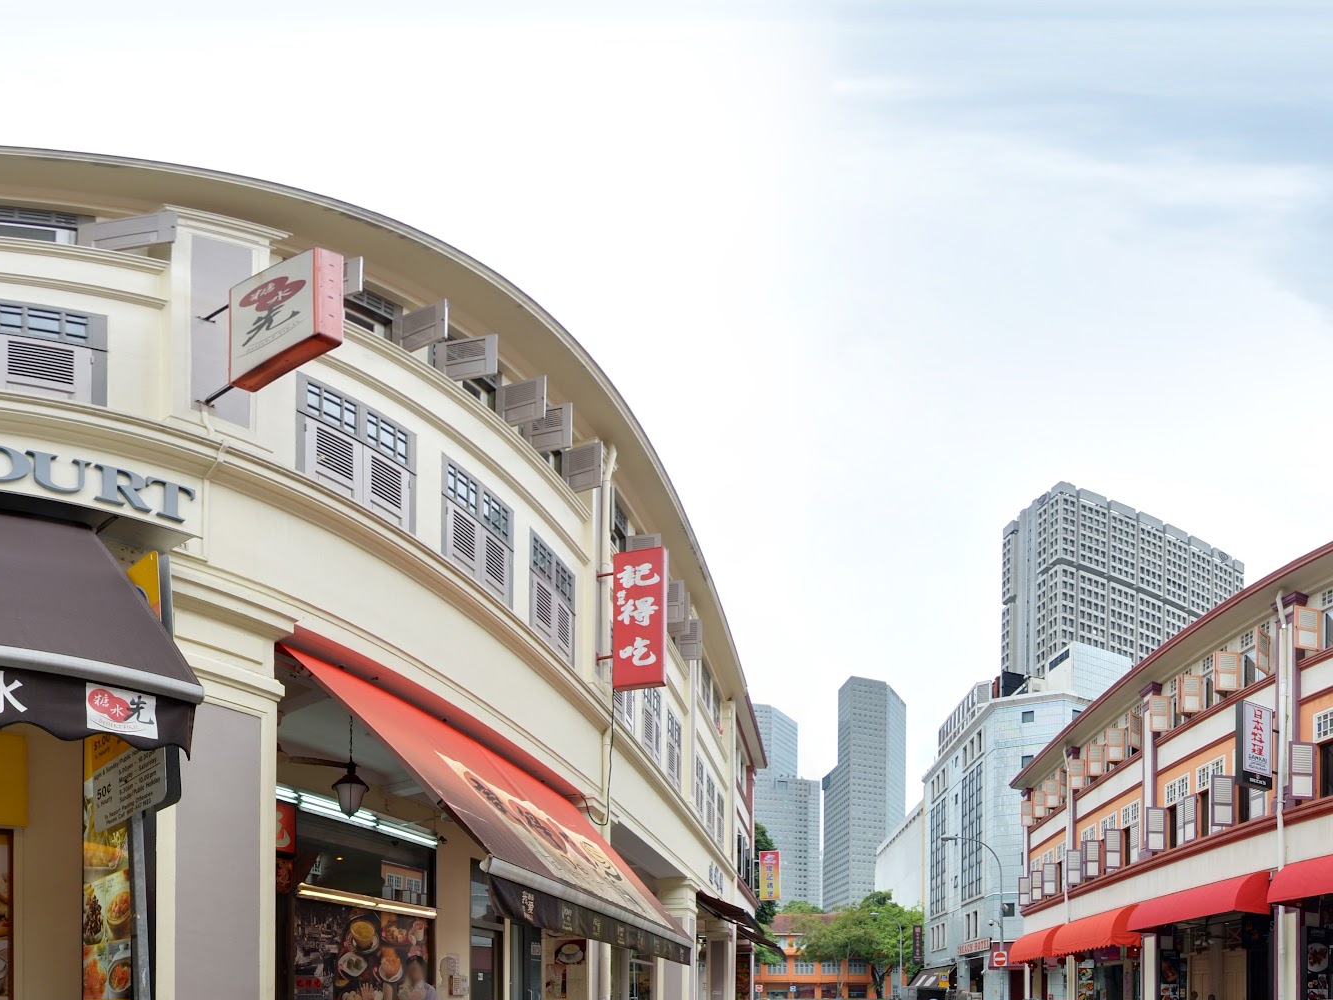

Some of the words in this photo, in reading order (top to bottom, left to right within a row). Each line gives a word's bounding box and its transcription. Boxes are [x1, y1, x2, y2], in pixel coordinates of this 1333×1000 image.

[617, 563, 660, 667] 記得吃
[1251, 708, 1265, 756] 日本料理
[959, 943, 973, 955] BEACH
[974, 939, 990, 950] HOTEL
